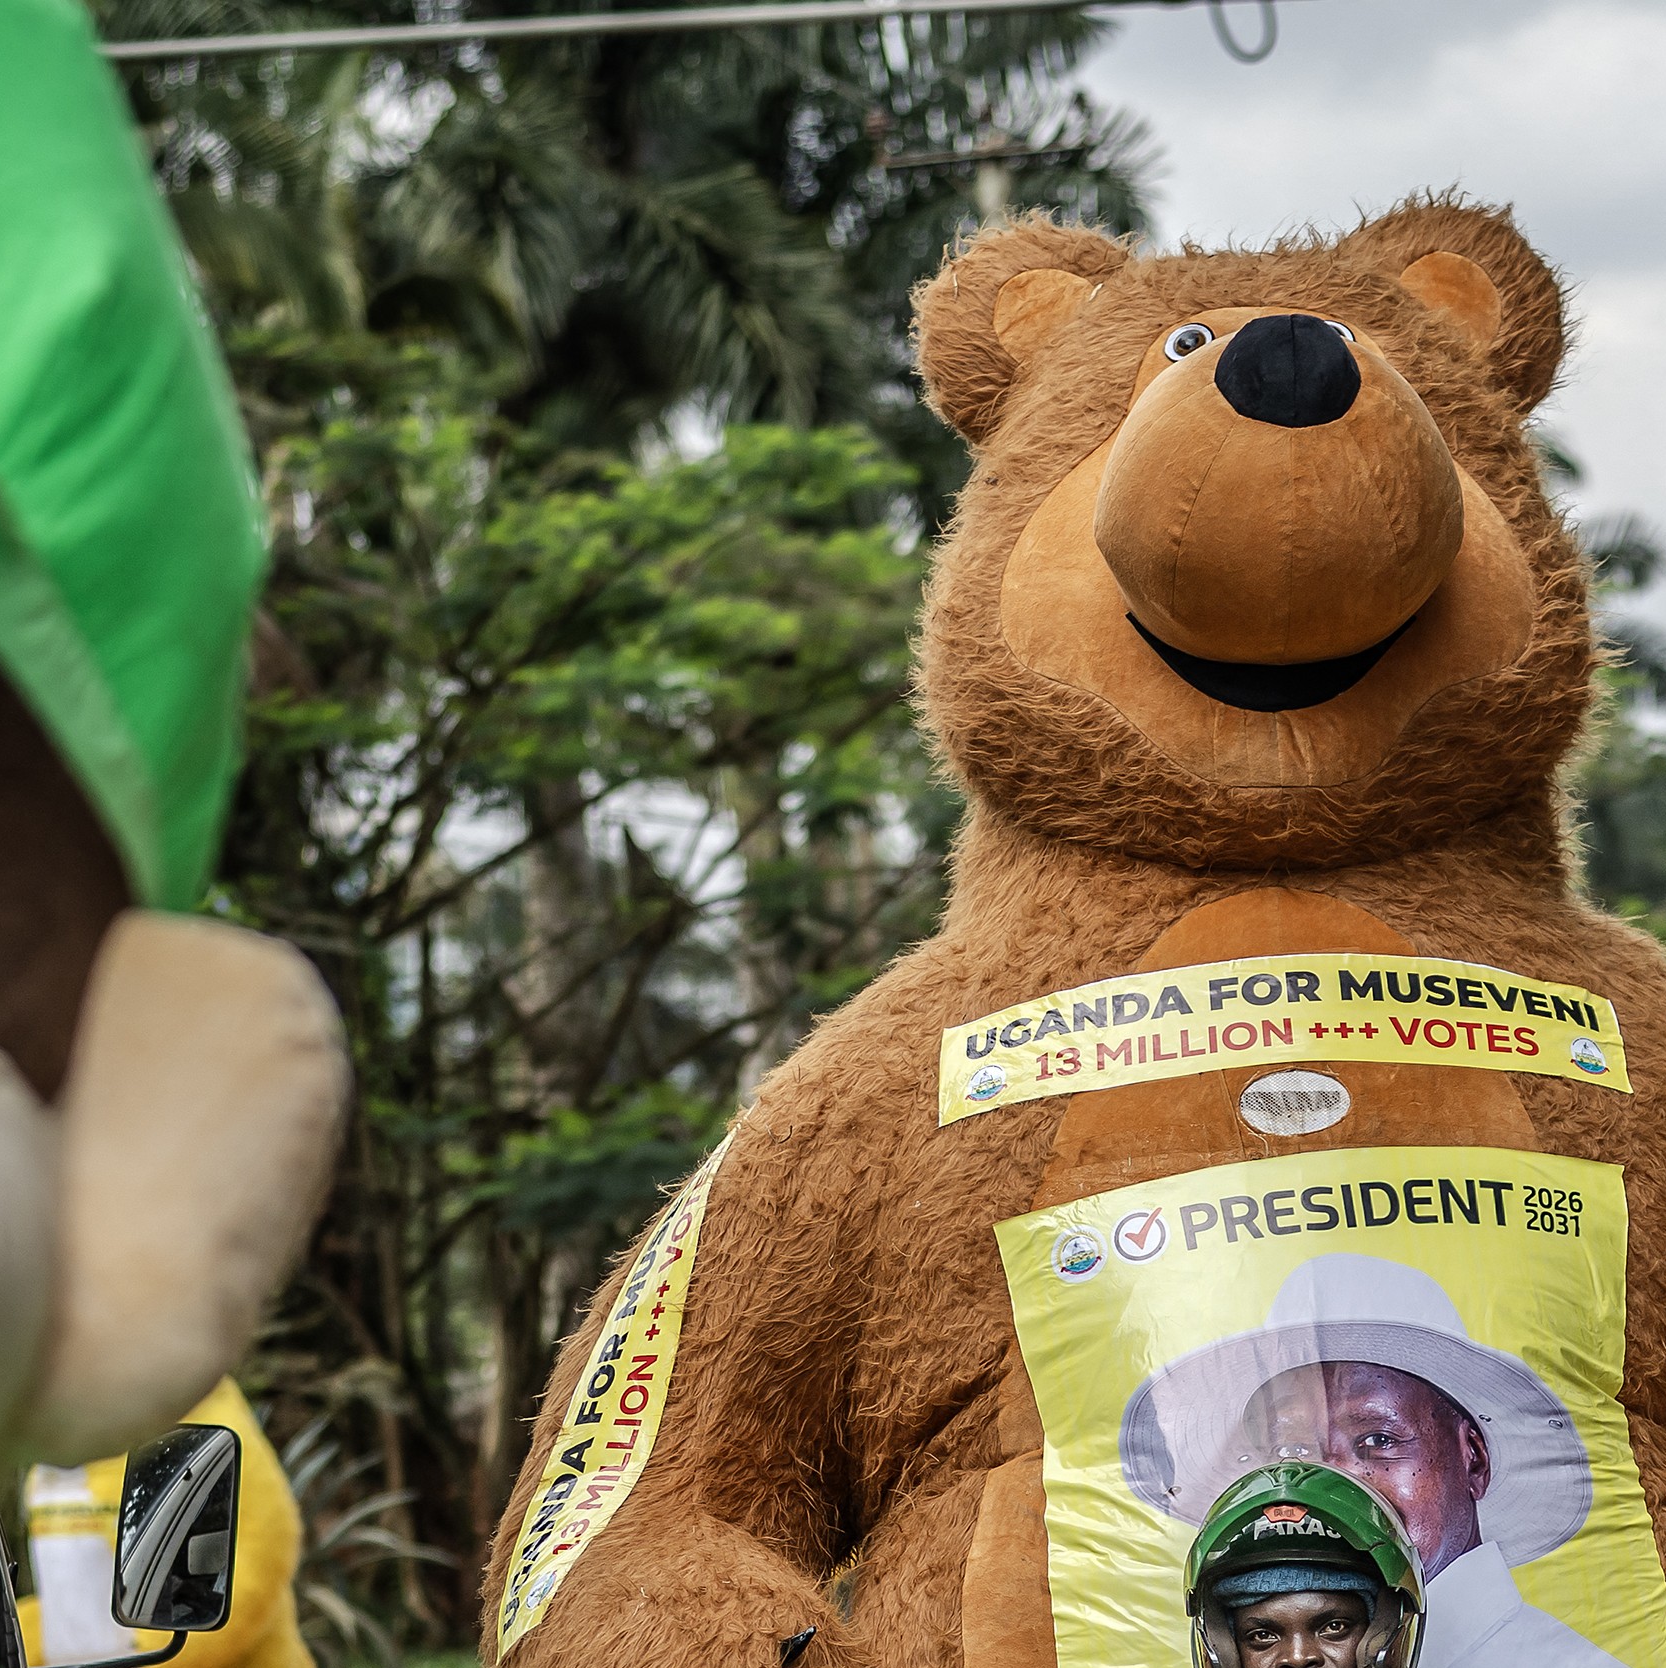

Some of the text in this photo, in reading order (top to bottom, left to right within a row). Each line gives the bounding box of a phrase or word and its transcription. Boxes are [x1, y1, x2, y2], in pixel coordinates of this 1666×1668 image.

[965, 969, 1599, 1060] UGANDA FOR MUSEVENI
[1035, 1048, 1082, 1081] 13
[1096, 1017, 1294, 1072] MILLION
[1388, 1017, 1541, 1057] VOTES
[1179, 1178, 1584, 1251] PRESIDENT 2026
[1525, 1211, 1581, 1238] 2031
[574, 1331, 627, 1425] FOR
[552, 1519, 590, 1555] 13
[575, 1354, 658, 1511] MILLION
